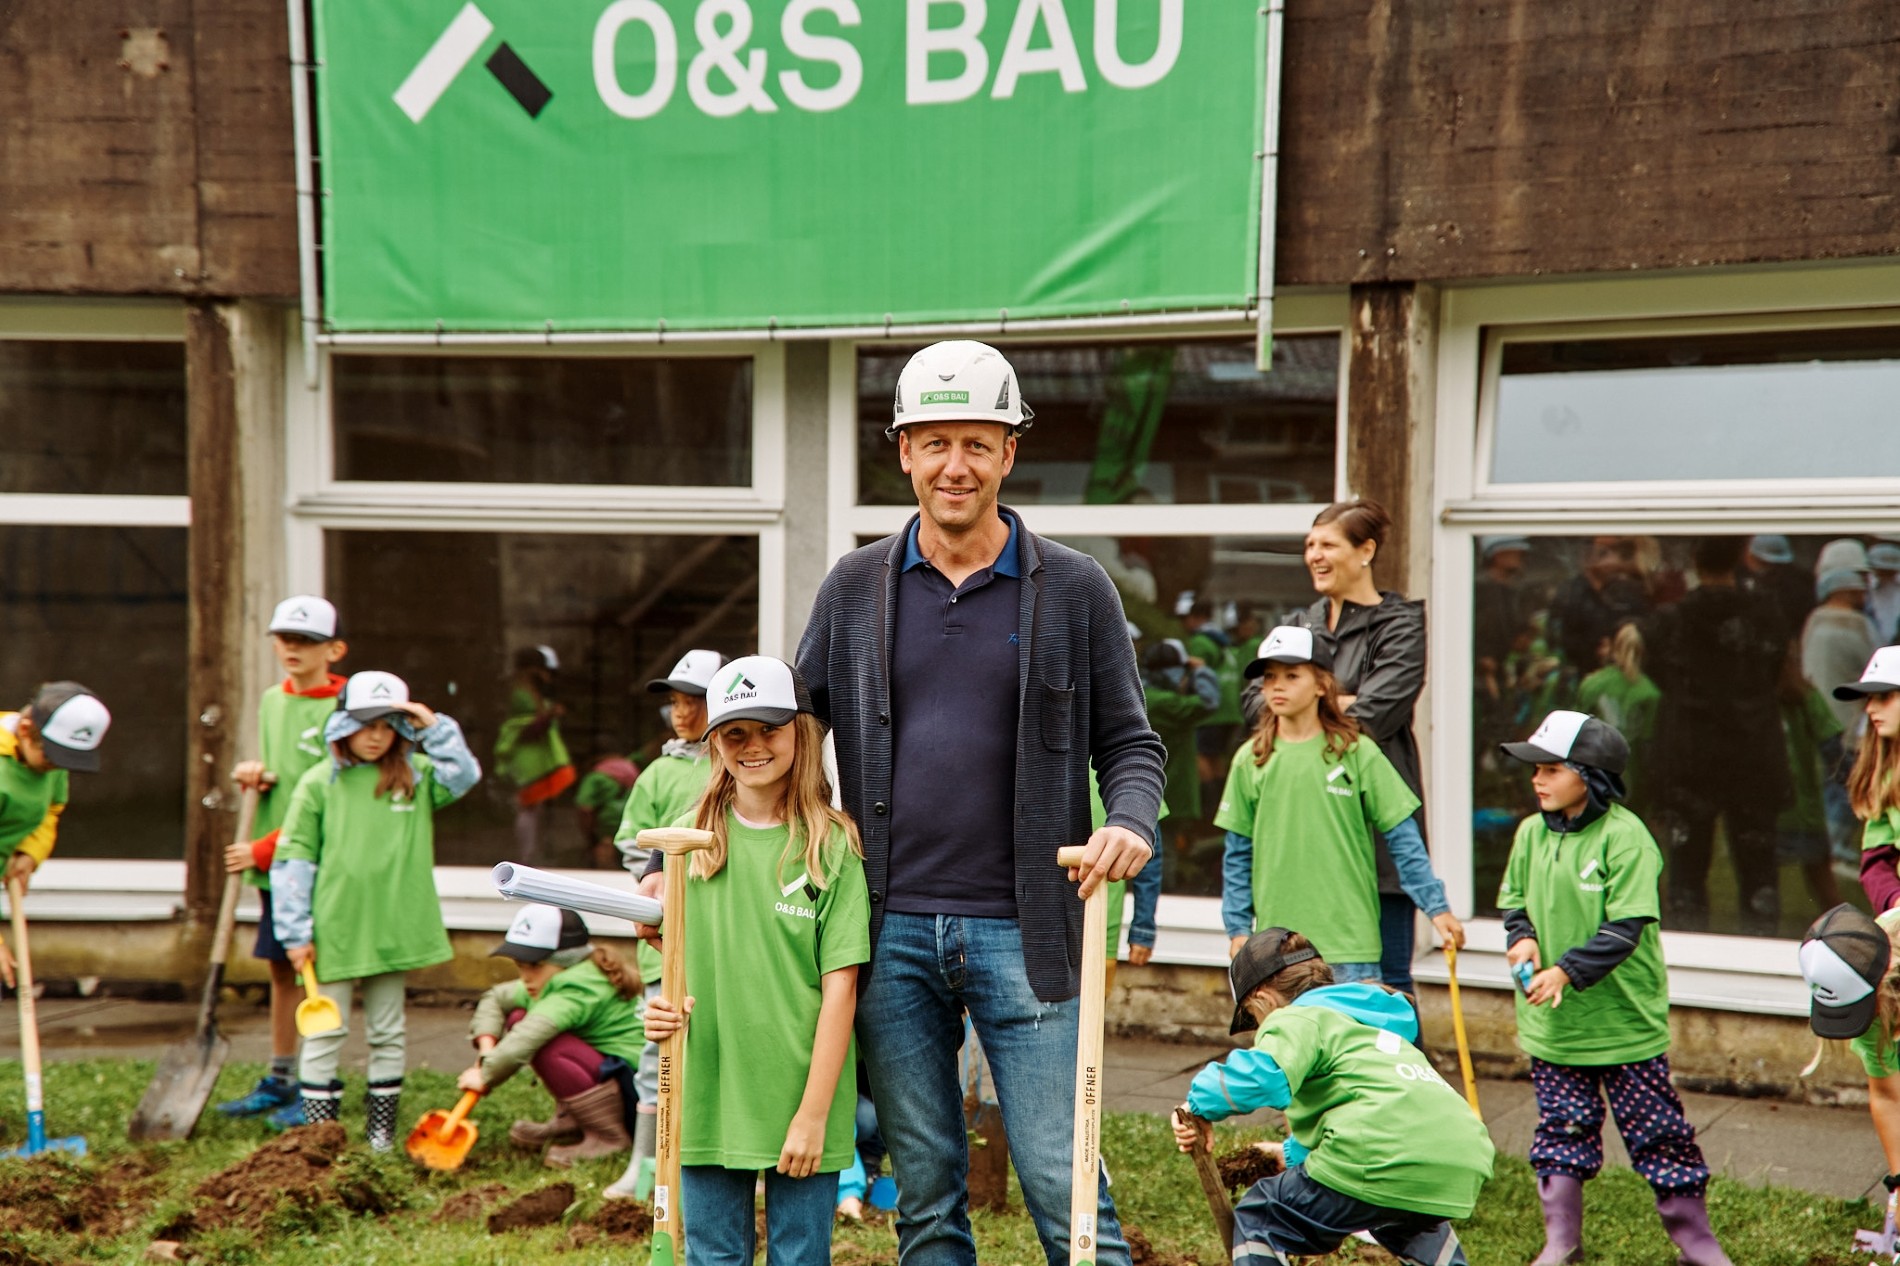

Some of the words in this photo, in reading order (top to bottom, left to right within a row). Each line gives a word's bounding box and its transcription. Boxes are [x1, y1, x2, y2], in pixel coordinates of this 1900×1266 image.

[592, 0, 863, 119] O&S
[905, 0, 1184, 105] BAU
[933, 393, 950, 401] O&S
[950, 393, 967, 401] BAU
[723, 693, 739, 703] O&S
[740, 691, 757, 700] BAU
[774, 901, 796, 915] O&S
[796, 906, 816, 919] BAU
[661, 1056, 670, 1094] OFFNER
[1086, 1066, 1096, 1105] OFFNER
